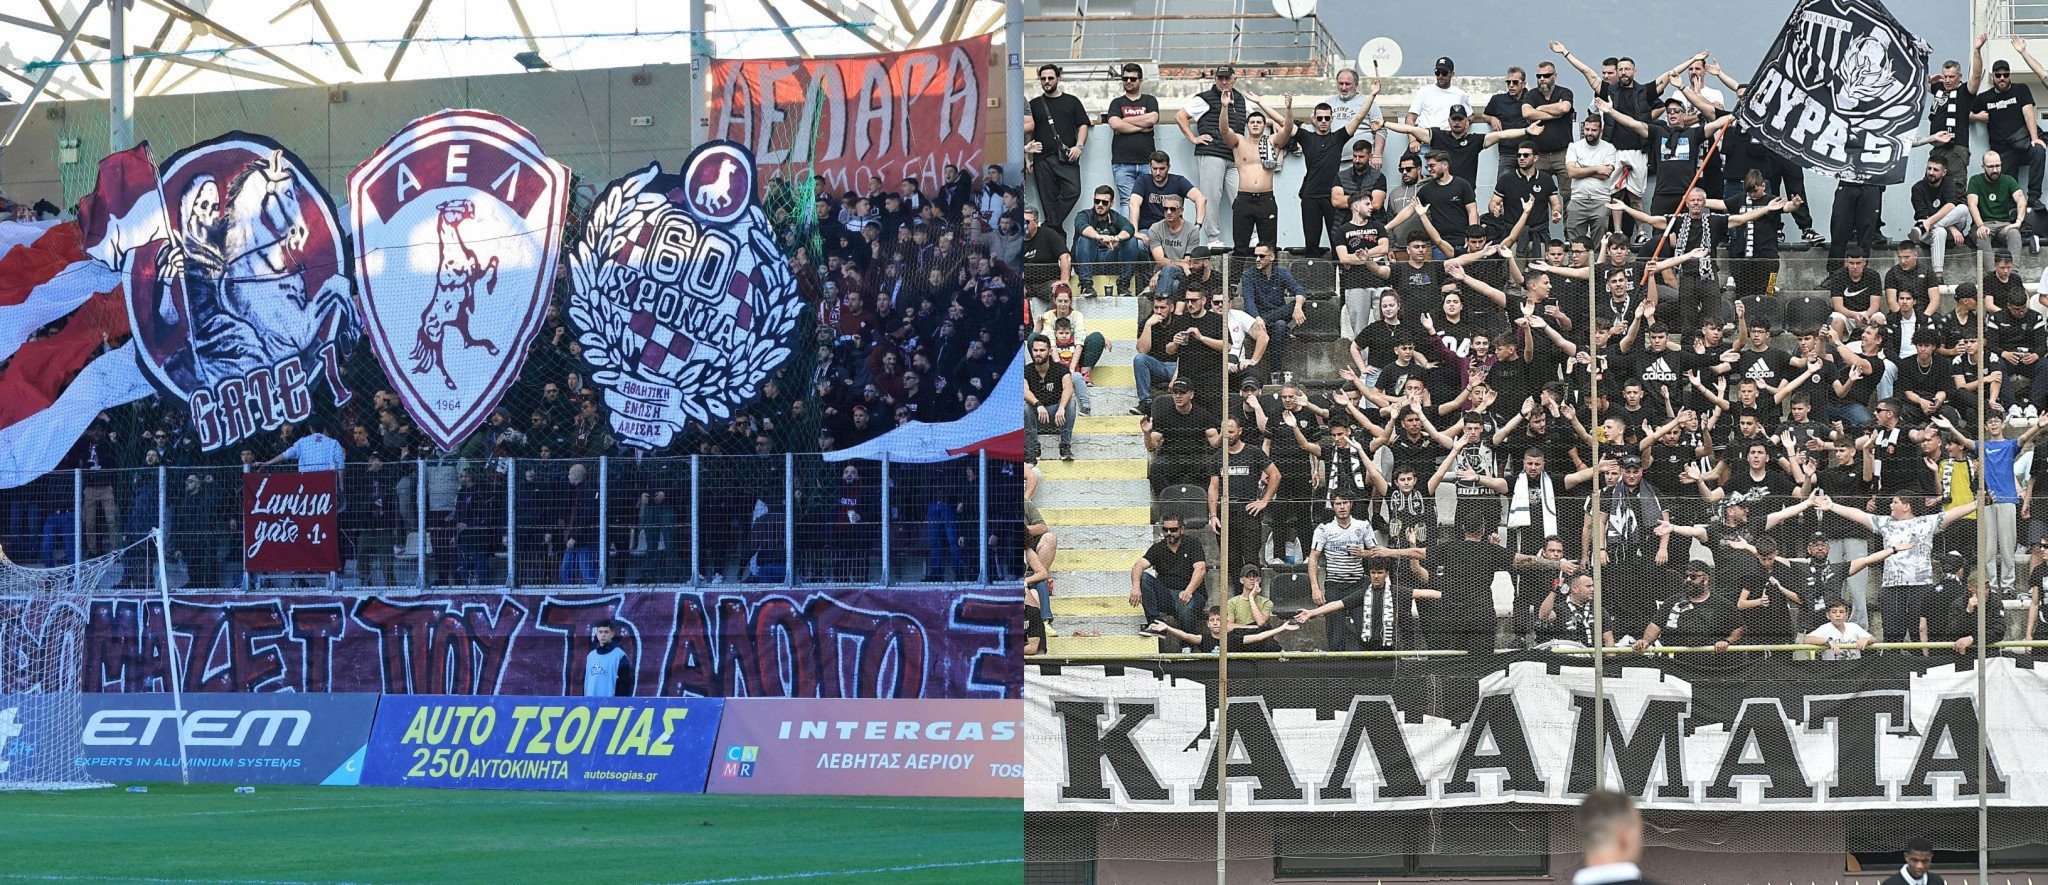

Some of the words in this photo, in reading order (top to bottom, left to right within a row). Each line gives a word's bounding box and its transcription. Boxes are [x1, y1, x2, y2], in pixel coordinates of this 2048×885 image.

[1860, 131, 1894, 164] 5
[643, 208, 740, 307] 60
[609, 264, 738, 350] ΧΡΟΝΙΑ
[1642, 371, 1677, 381] adidas
[1745, 370, 1775, 379] adidas
[190, 356, 312, 452] GATE
[436, 399, 461, 411] 1964
[251, 478, 333, 515] Larissa
[247, 516, 299, 559] gate
[82, 709, 312, 746] ETEM
[401, 705, 497, 745] AUTO
[505, 705, 689, 756] ΤΣΟΓΙΑΣ
[75, 757, 133, 767] EXPERTS
[136, 757, 151, 767] IN
[154, 757, 234, 768] ALUMINIUM
[238, 758, 301, 768] SYSTEMS
[816, 752, 902, 769] ΛΕΒΗΤΑΣ
[904, 753, 975, 770] ΑΕΡΙΟΥ
[1049, 689, 2011, 805] ΚΑΛΑΜΑΤΑ
[407, 748, 470, 778] 250
[467, 759, 569, 780] ΑΥΤΟΚΙΝΗΤΑ
[583, 770, 658, 782] autotsogias.gr
[989, 763, 1024, 778] TOS
